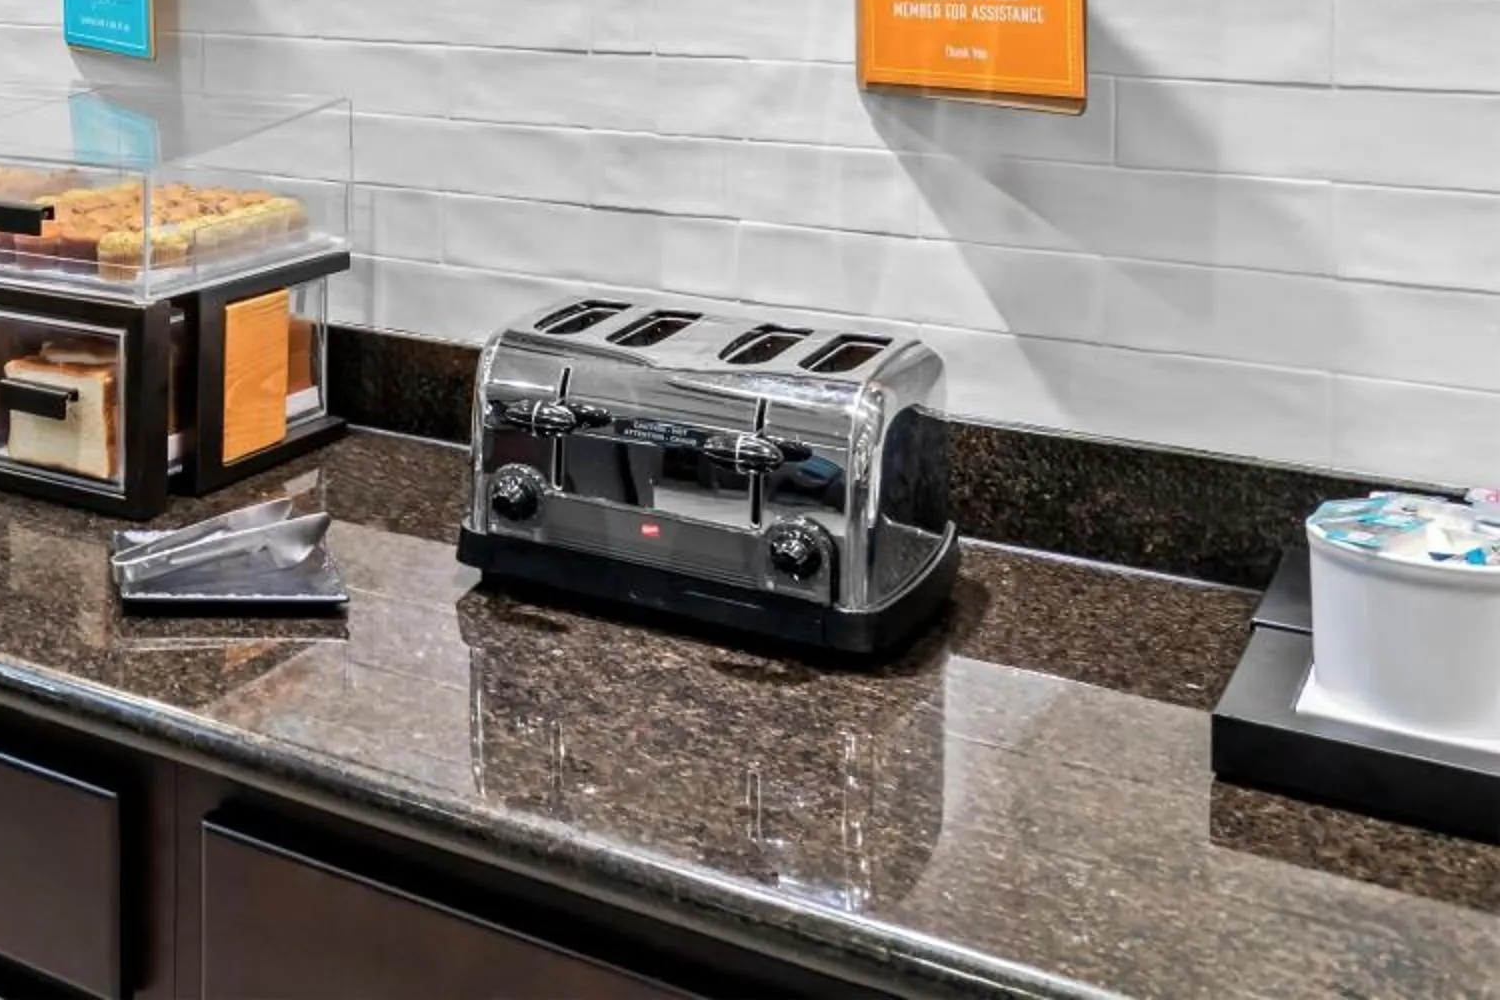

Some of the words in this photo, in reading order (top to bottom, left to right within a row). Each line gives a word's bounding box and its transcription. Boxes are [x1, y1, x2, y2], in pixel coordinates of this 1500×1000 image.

[893, 0, 942, 20] MEMBER
[945, 2, 968, 21] FOR
[971, 4, 1045, 25] ASSISTANCE
